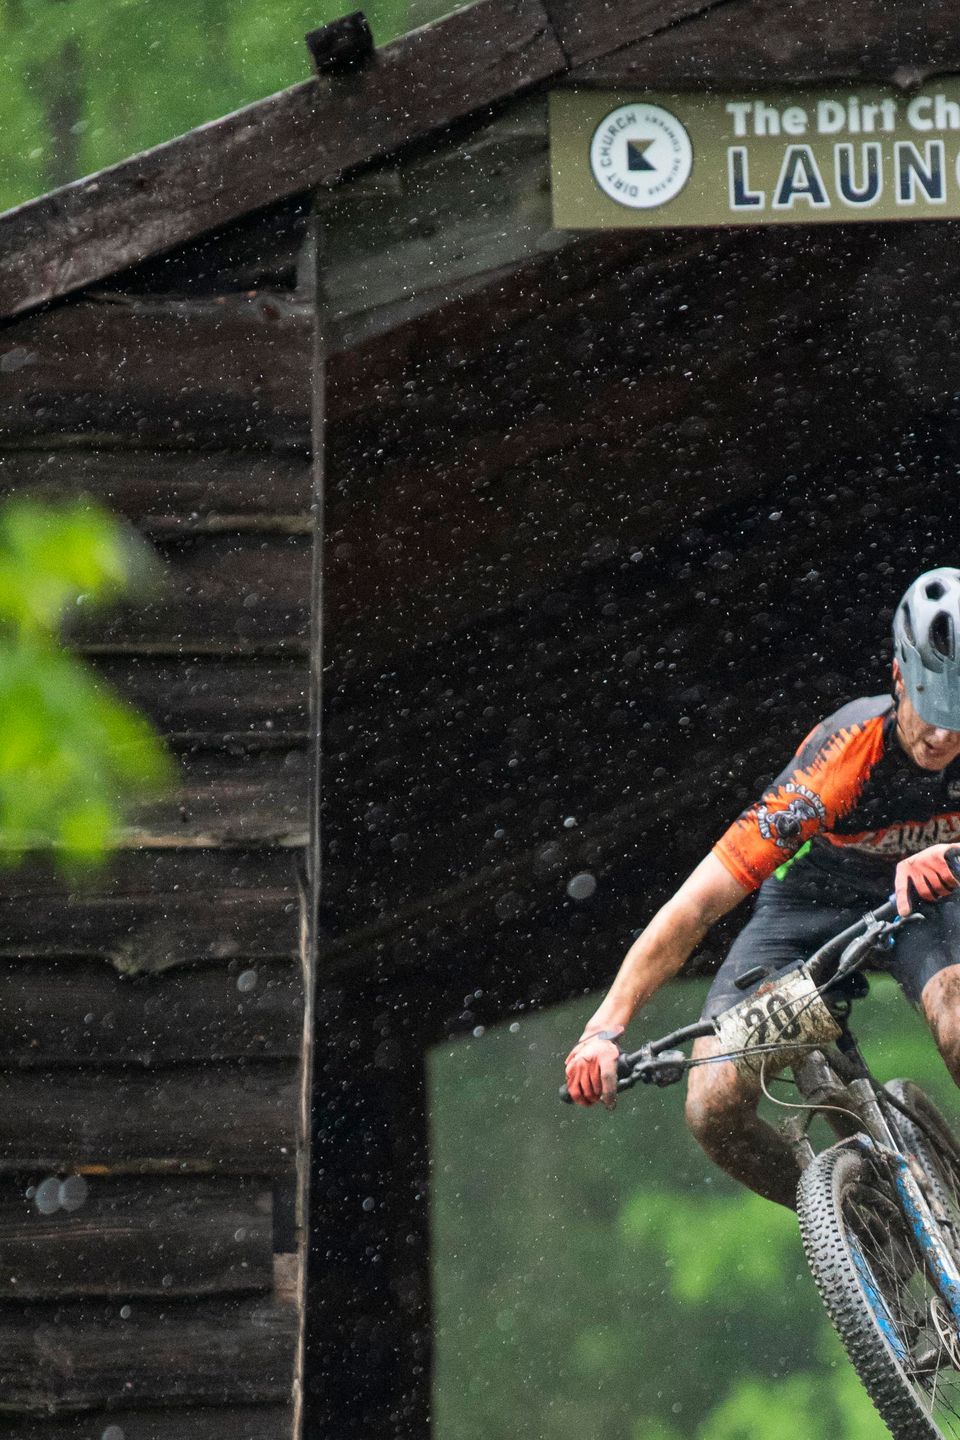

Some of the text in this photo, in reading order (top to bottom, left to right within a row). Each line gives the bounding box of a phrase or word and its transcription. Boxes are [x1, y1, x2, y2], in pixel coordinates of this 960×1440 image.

[727, 101, 807, 135] The
[816, 95, 895, 134] Dirt
[600, 112, 639, 198] DIRT CHURCH
